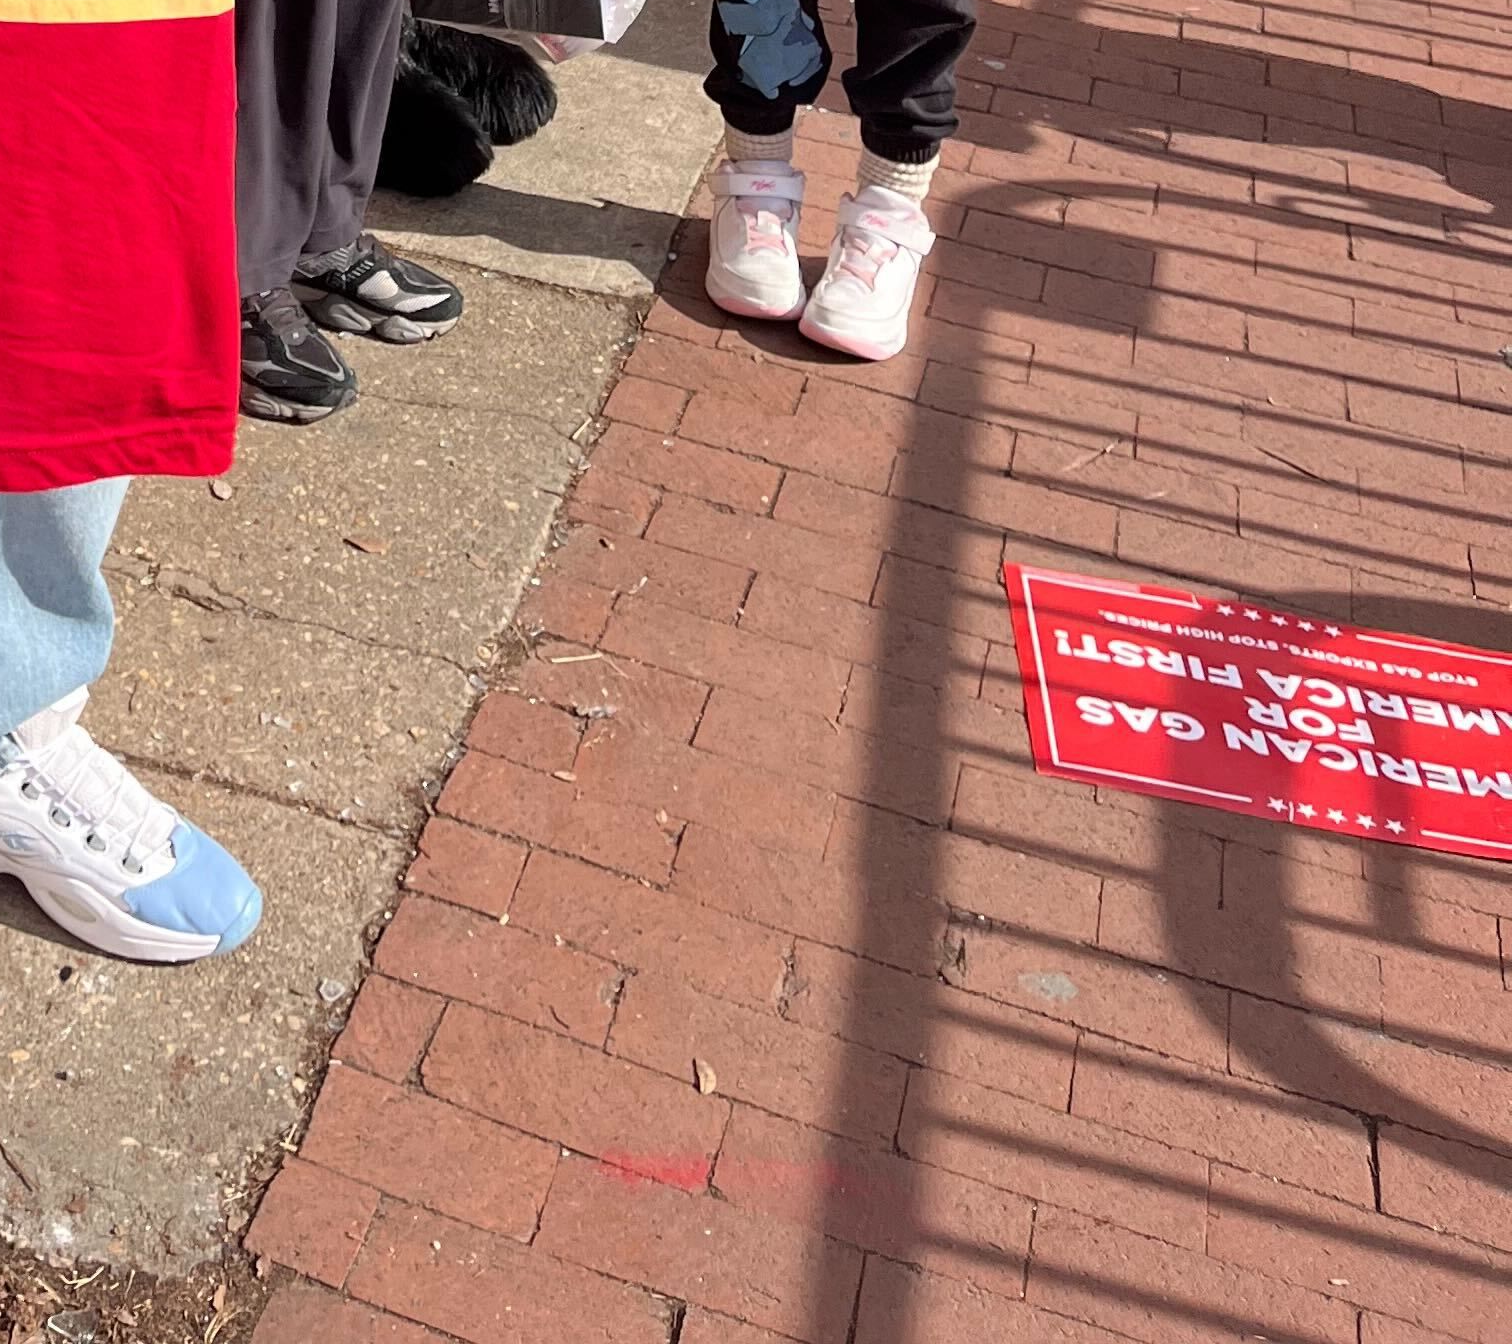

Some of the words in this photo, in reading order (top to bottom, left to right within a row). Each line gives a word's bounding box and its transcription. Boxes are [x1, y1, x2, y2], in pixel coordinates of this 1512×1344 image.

[1175, 624, 1224, 642] HIGH
[1228, 634, 1279, 651] STOP
[1054, 629, 1244, 689] FIRST!
[1381, 663, 1423, 679] GAS
[1427, 671, 1479, 687] STOP
[1075, 695, 1206, 741] GAS
[1243, 696, 1376, 745] FOR
